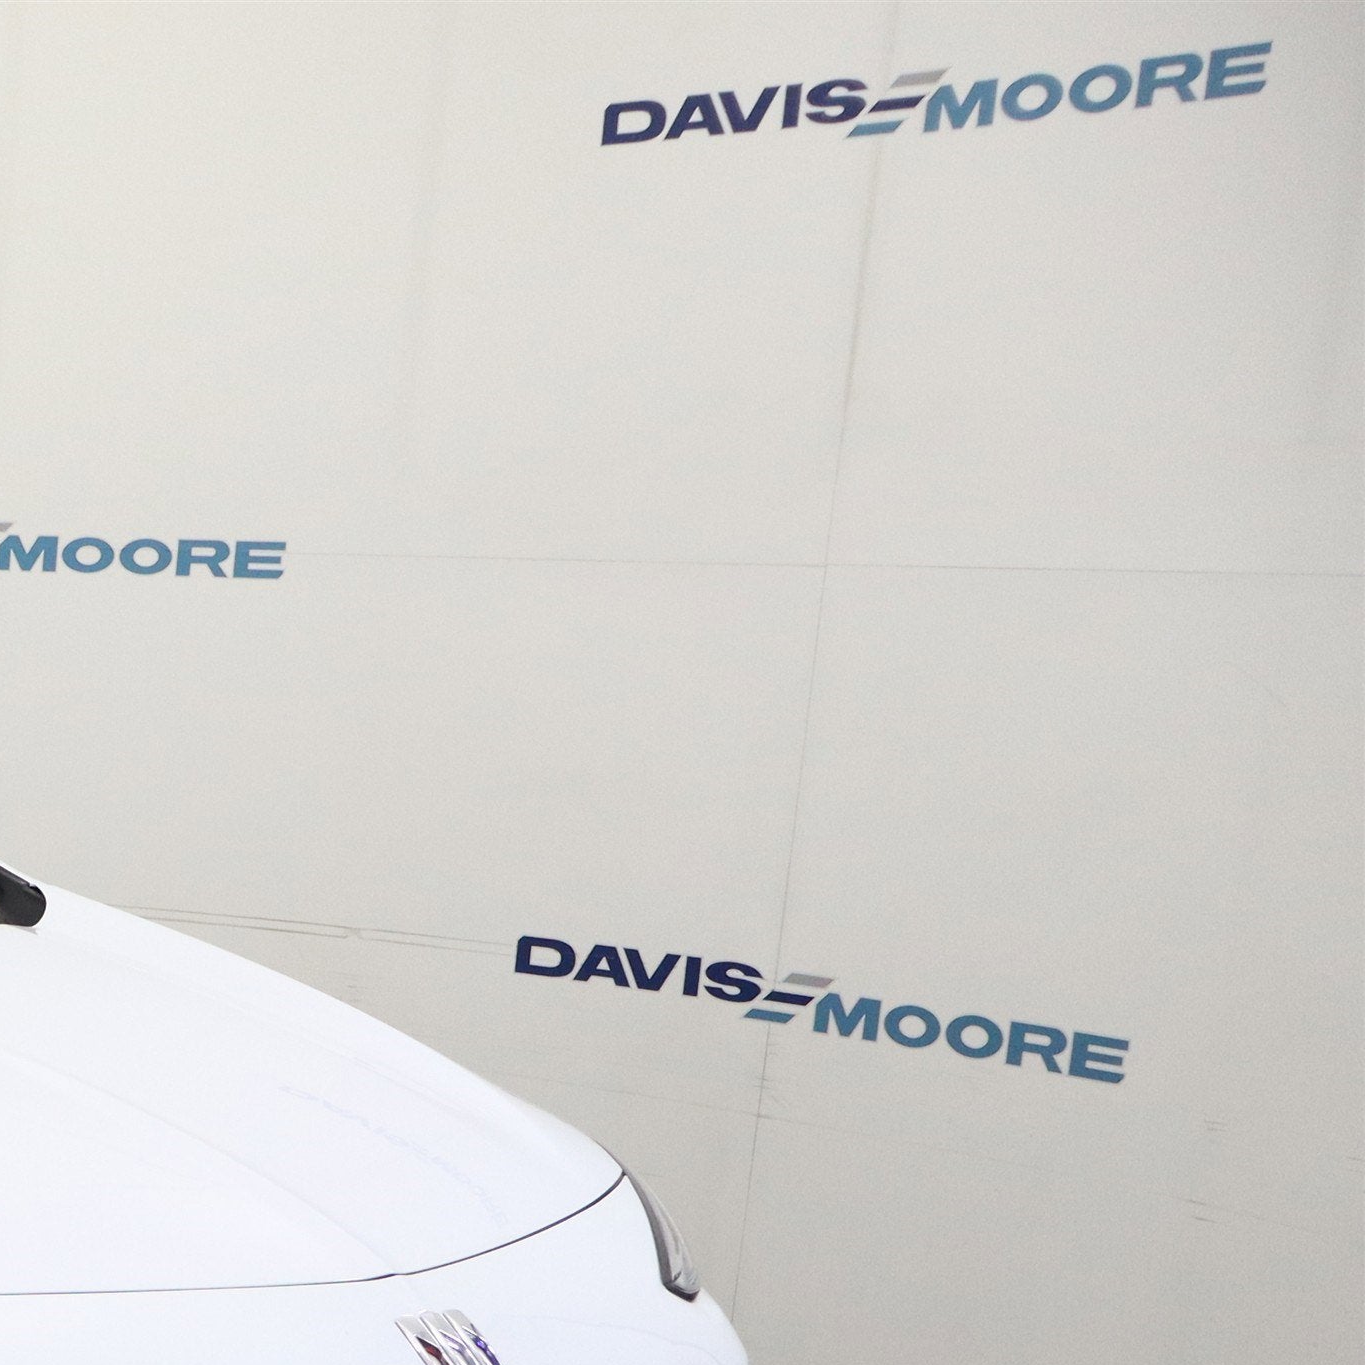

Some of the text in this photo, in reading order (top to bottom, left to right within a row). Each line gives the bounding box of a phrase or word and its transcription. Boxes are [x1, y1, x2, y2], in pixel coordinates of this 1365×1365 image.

[600, 40, 1273, 147] DAVIS MOORE
[513, 934, 1131, 1085] DAVIS MOORE
